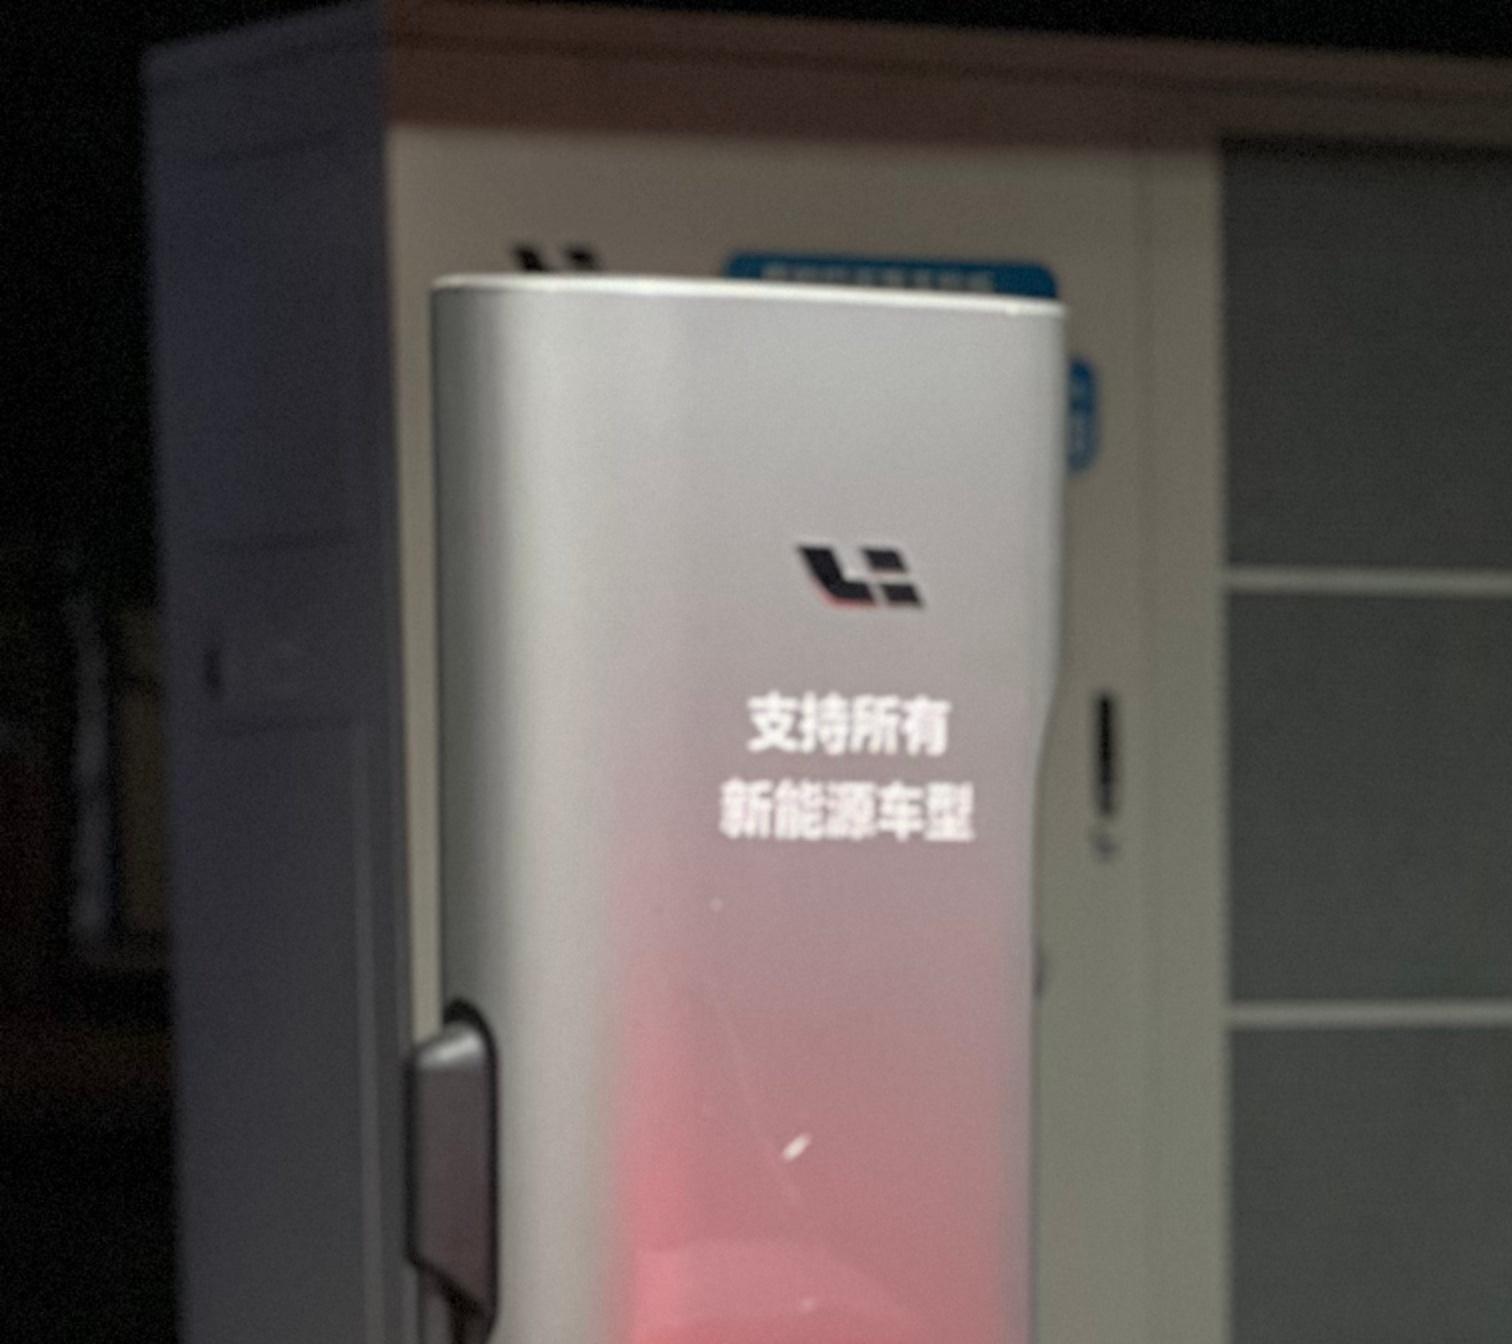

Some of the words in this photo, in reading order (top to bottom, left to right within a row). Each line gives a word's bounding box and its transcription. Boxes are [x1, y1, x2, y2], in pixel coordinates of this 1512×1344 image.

[746, 690, 952, 756] 支持所有
[719, 777, 976, 843] 新能源车型
